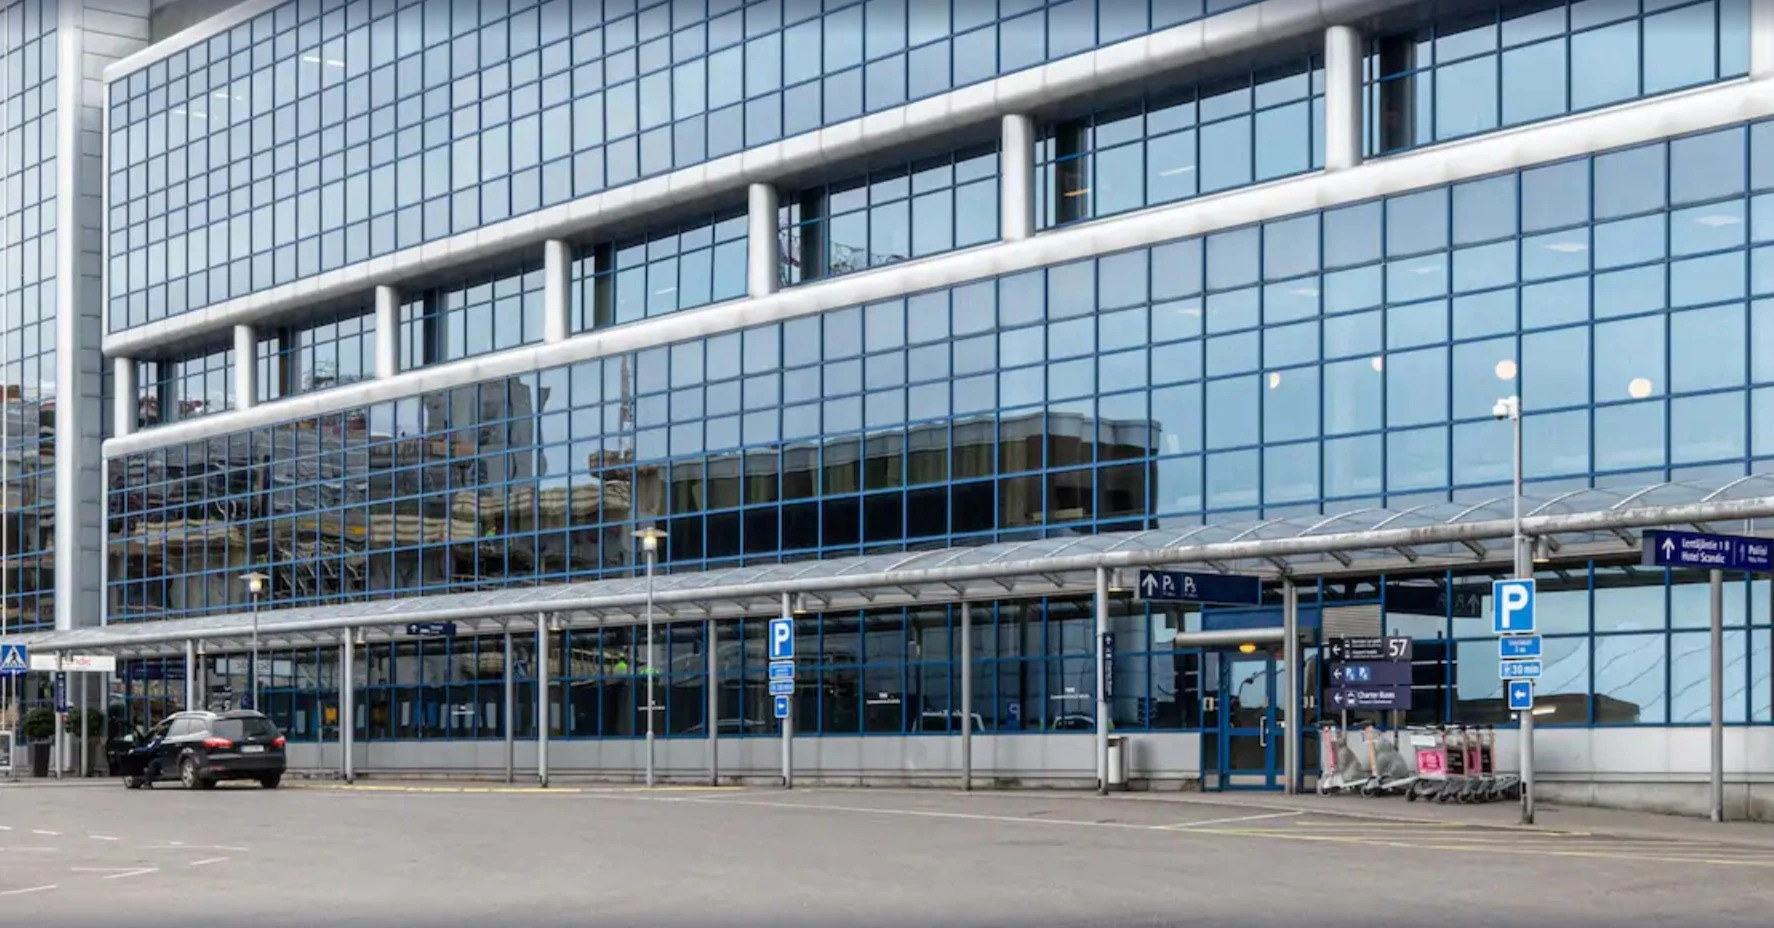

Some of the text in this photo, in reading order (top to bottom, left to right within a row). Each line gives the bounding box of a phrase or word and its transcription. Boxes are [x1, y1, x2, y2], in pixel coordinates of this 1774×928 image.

[1700, 552, 1725, 564] Scandic
[1502, 585, 1528, 628] P
[774, 623, 790, 656] P
[1389, 639, 1408, 656] 57
[1512, 664, 1539, 675] 30 min
